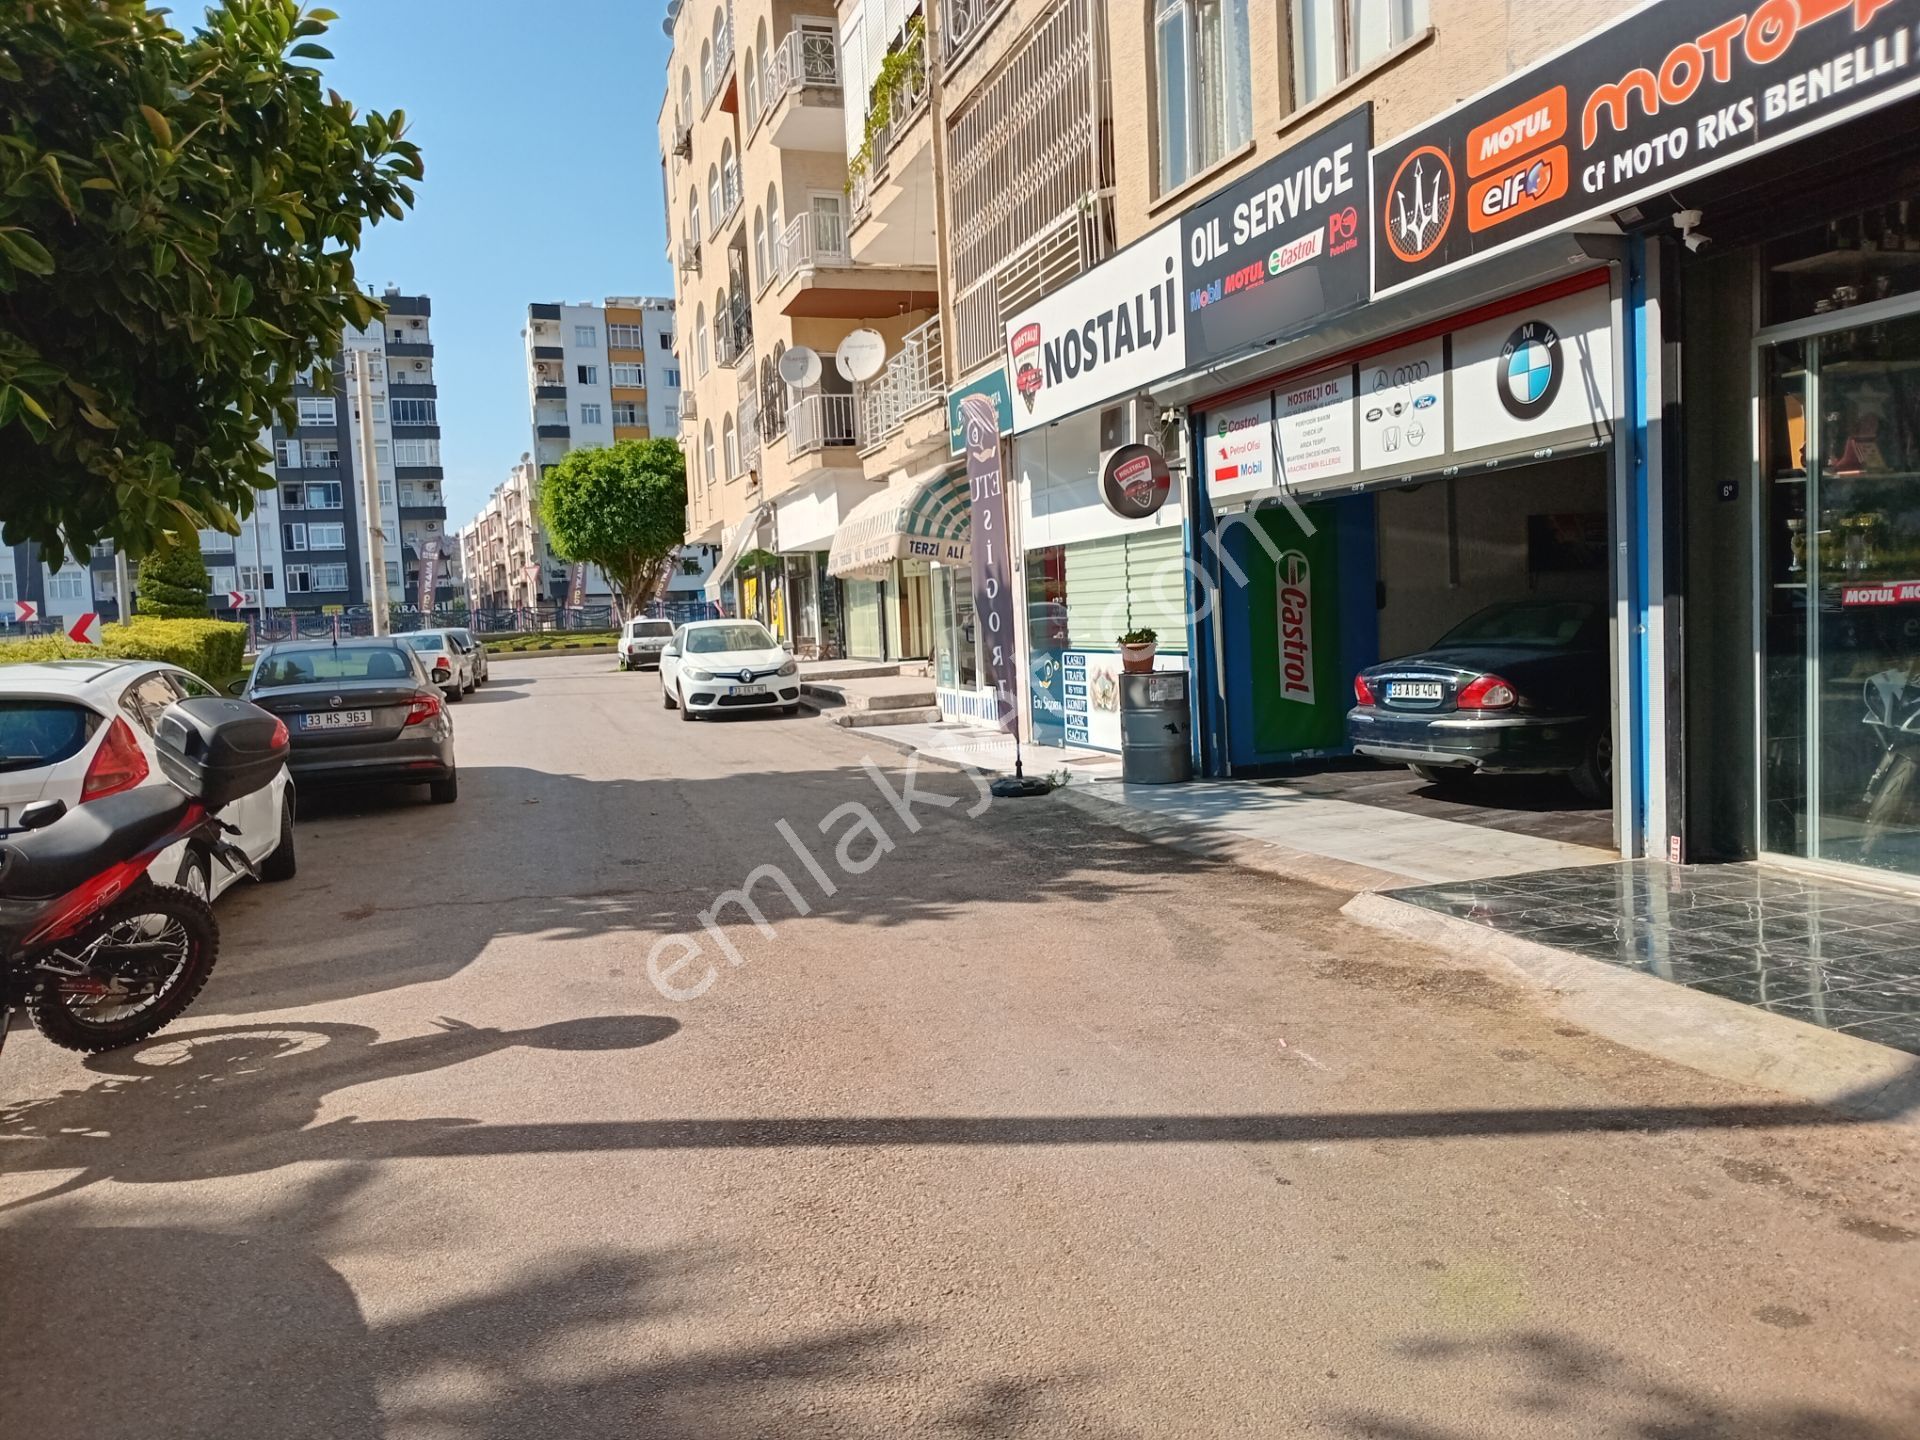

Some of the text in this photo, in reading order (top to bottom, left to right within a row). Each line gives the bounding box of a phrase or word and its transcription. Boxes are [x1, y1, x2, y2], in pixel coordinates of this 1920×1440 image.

[1613, 126, 1688, 183] MOTO
[1697, 96, 1754, 149] RKS
[1763, 27, 1908, 122] BENELLI
[1480, 107, 1552, 161] MOTUL
[1191, 143, 1353, 267] OIL SERVICE
[1482, 170, 1527, 216] elf
[1280, 235, 1317, 268] Castrol
[1224, 260, 1265, 294] MOTUL
[1189, 278, 1222, 312] Mobil
[1503, 323, 1557, 360] BMW
[1228, 414, 1260, 432] Castrol
[1240, 460, 1263, 476] Mobil
[909, 540, 965, 559] TERZİ ALİ
[1845, 589, 1895, 603] MOTUL
[1280, 587, 1310, 693] Castrol
[1391, 683, 1402, 697] 33
[1423, 683, 1439, 697] 404
[307, 714, 321, 726] 33
[326, 713, 340, 723] HS
[346, 711, 367, 723] 963
[1069, 714, 1085, 725] DASK
